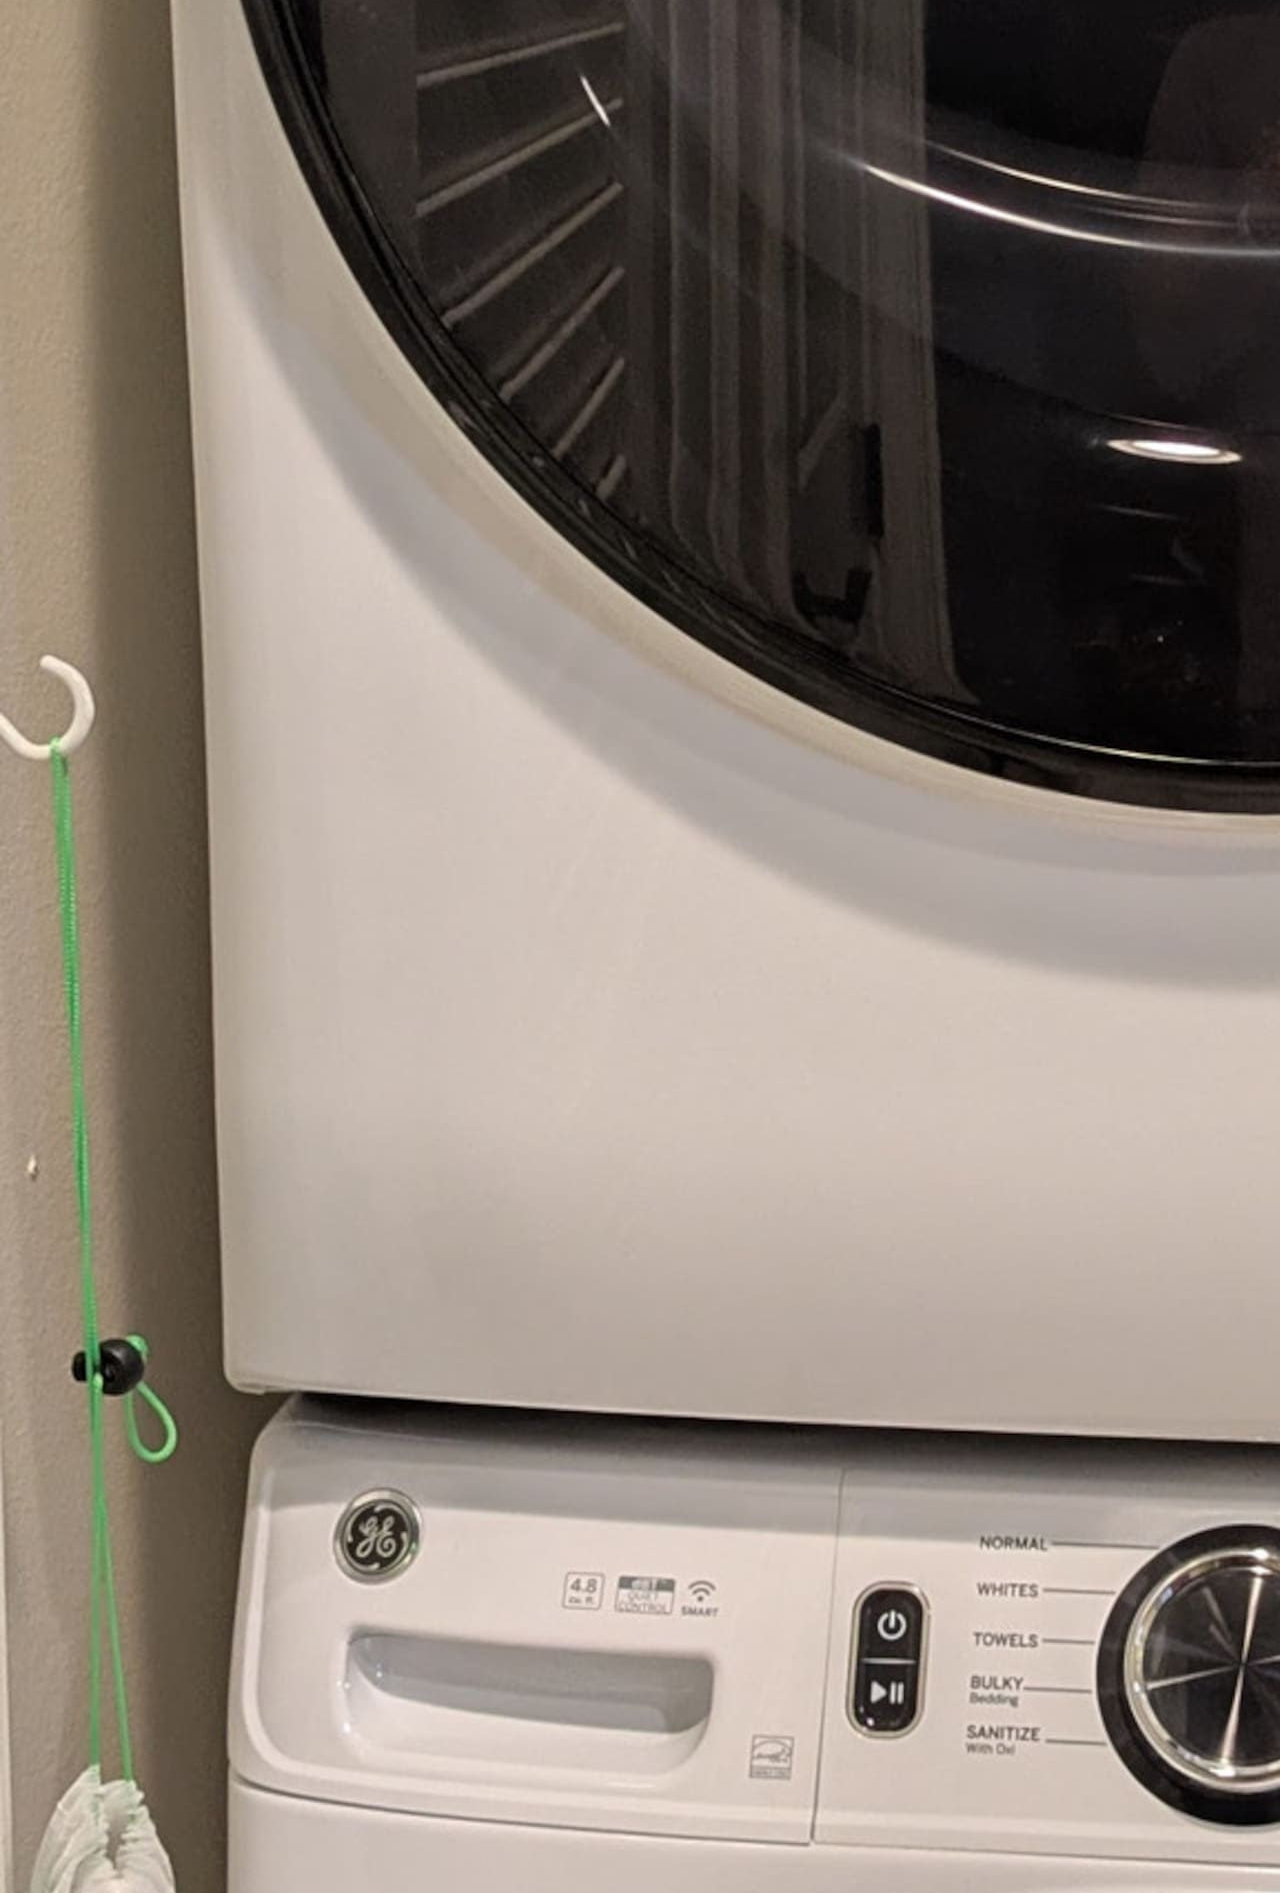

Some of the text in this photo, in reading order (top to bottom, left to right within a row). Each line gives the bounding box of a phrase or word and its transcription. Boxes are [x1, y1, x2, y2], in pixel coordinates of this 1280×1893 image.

[979, 1536, 1048, 1551] NORMAL
[570, 1578, 598, 1593] 4.8
[977, 1583, 1039, 1597] WHITES
[681, 1605, 718, 1617] SMART
[973, 1632, 1038, 1648] TOWELS
[971, 1675, 1023, 1690] BULKY
[969, 1692, 1019, 1707] Bedding
[966, 1725, 1040, 1742] SANITIZE
[965, 1743, 993, 1755] With
